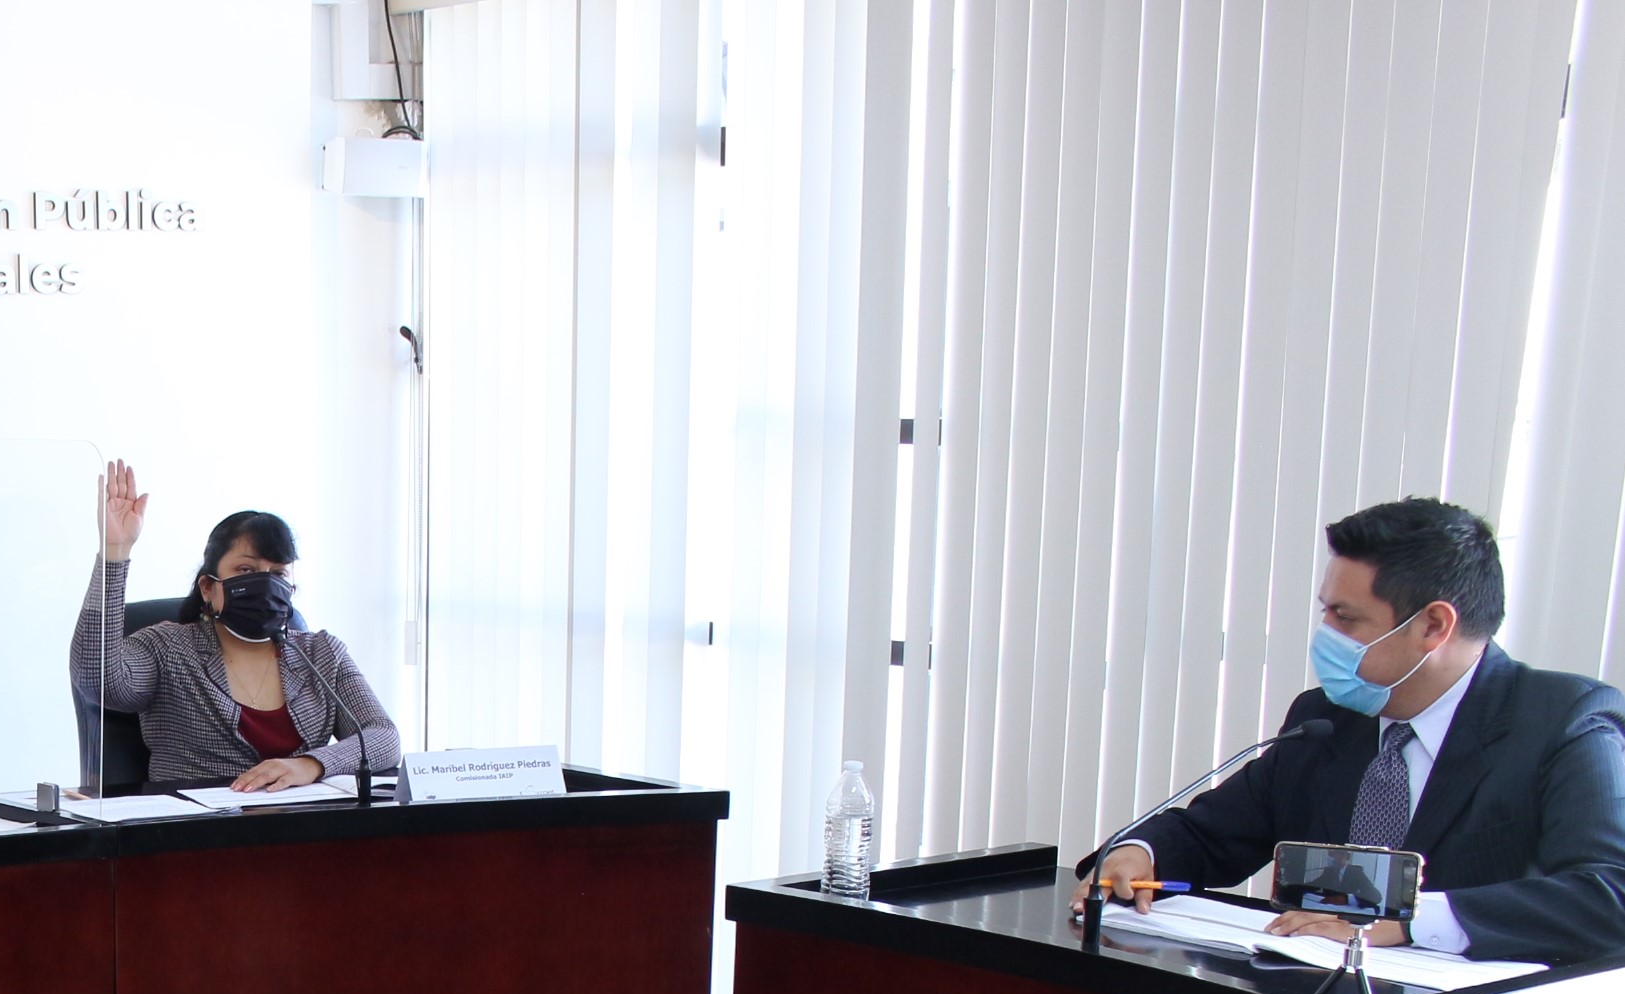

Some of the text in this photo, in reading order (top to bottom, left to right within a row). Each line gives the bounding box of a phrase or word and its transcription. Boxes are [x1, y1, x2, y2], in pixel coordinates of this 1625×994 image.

[32, 188, 205, 231] Pública
[413, 765, 429, 775] Lic.
[431, 763, 466, 774] Maribel
[517, 759, 552, 769] Piedras
